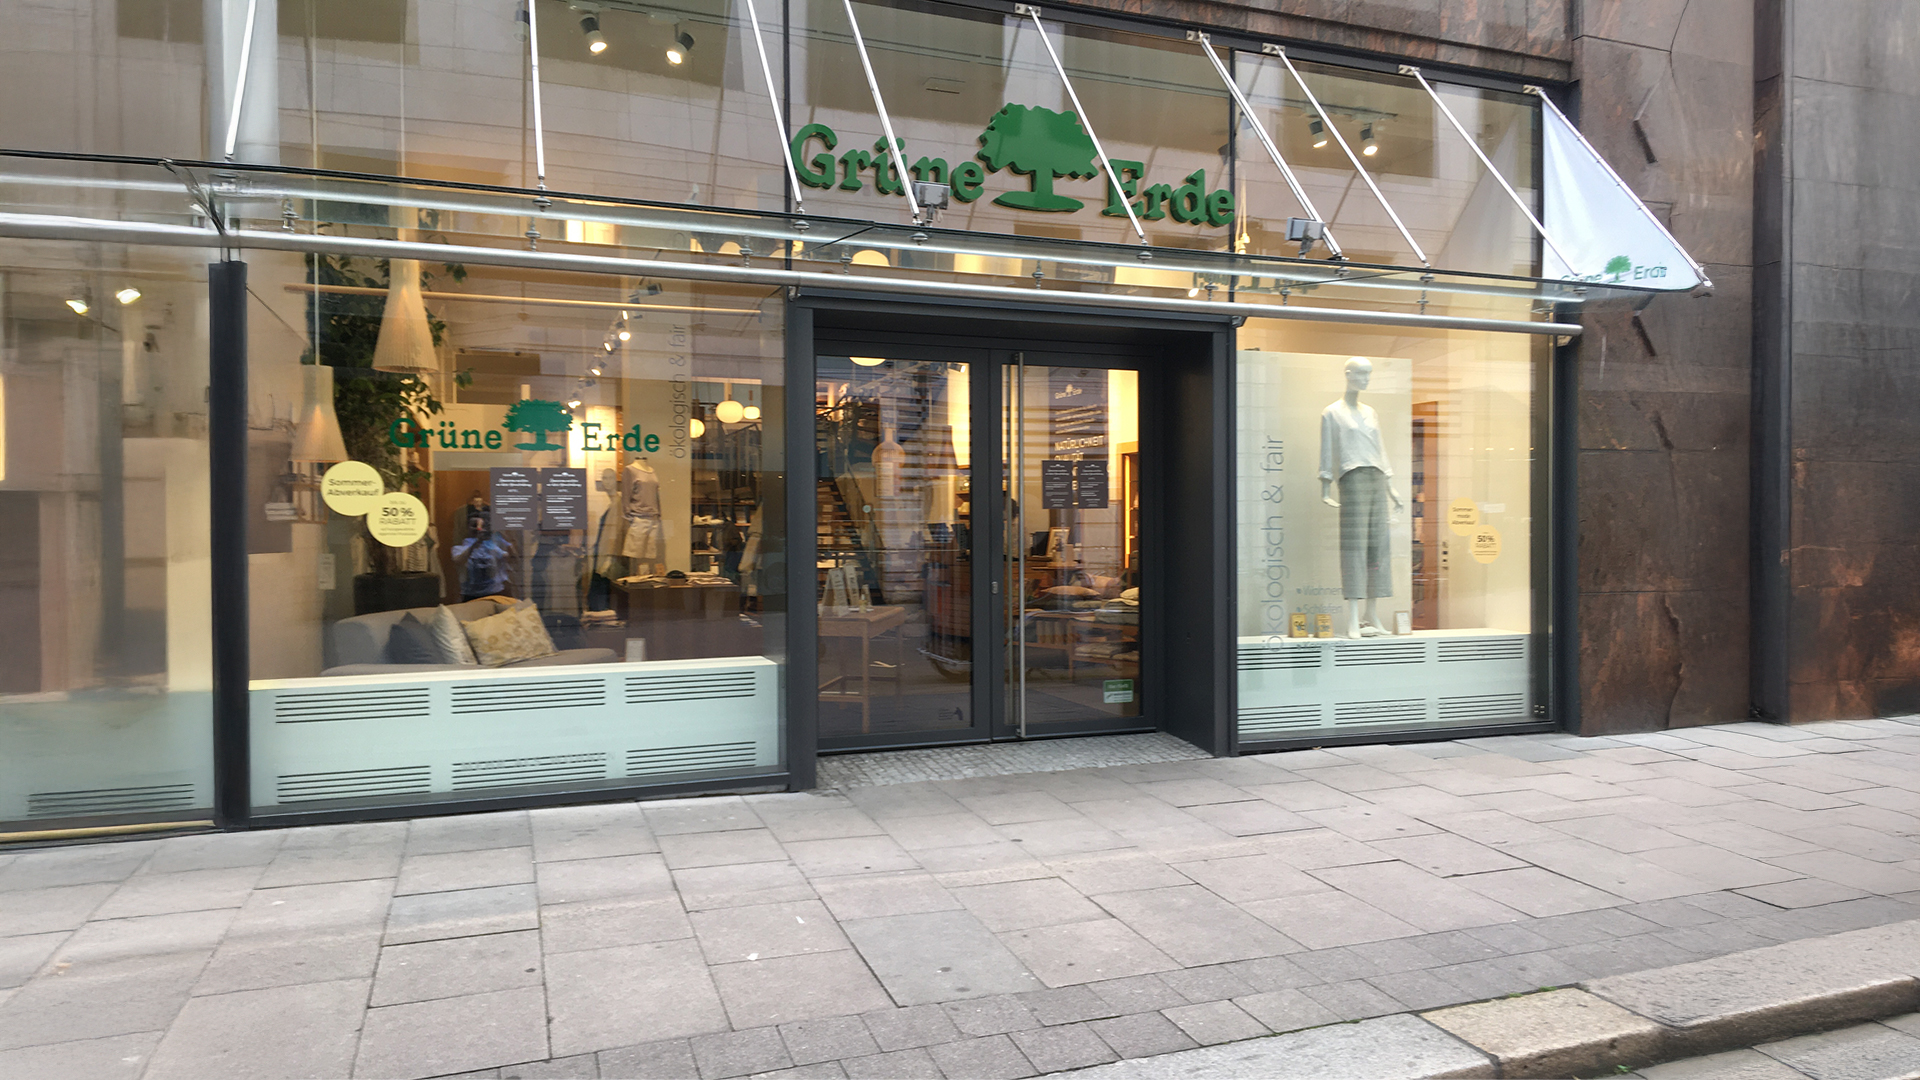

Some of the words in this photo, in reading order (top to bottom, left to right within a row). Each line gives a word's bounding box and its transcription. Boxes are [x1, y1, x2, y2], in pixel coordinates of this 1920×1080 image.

[789, 122, 985, 203] Grüne
[1101, 157, 1236, 228] Erde
[667, 323, 686, 347] fair
[668, 354, 687, 367] &
[668, 372, 691, 459] ökologisch
[389, 417, 503, 449] Grüne
[580, 423, 661, 452] Erde
[1260, 434, 1284, 473] fair
[327, 488, 380, 496] Abverkauf
[328, 479, 377, 487] Sommer-
[1260, 484, 1284, 504] &
[1260, 515, 1290, 652] ökologisch
